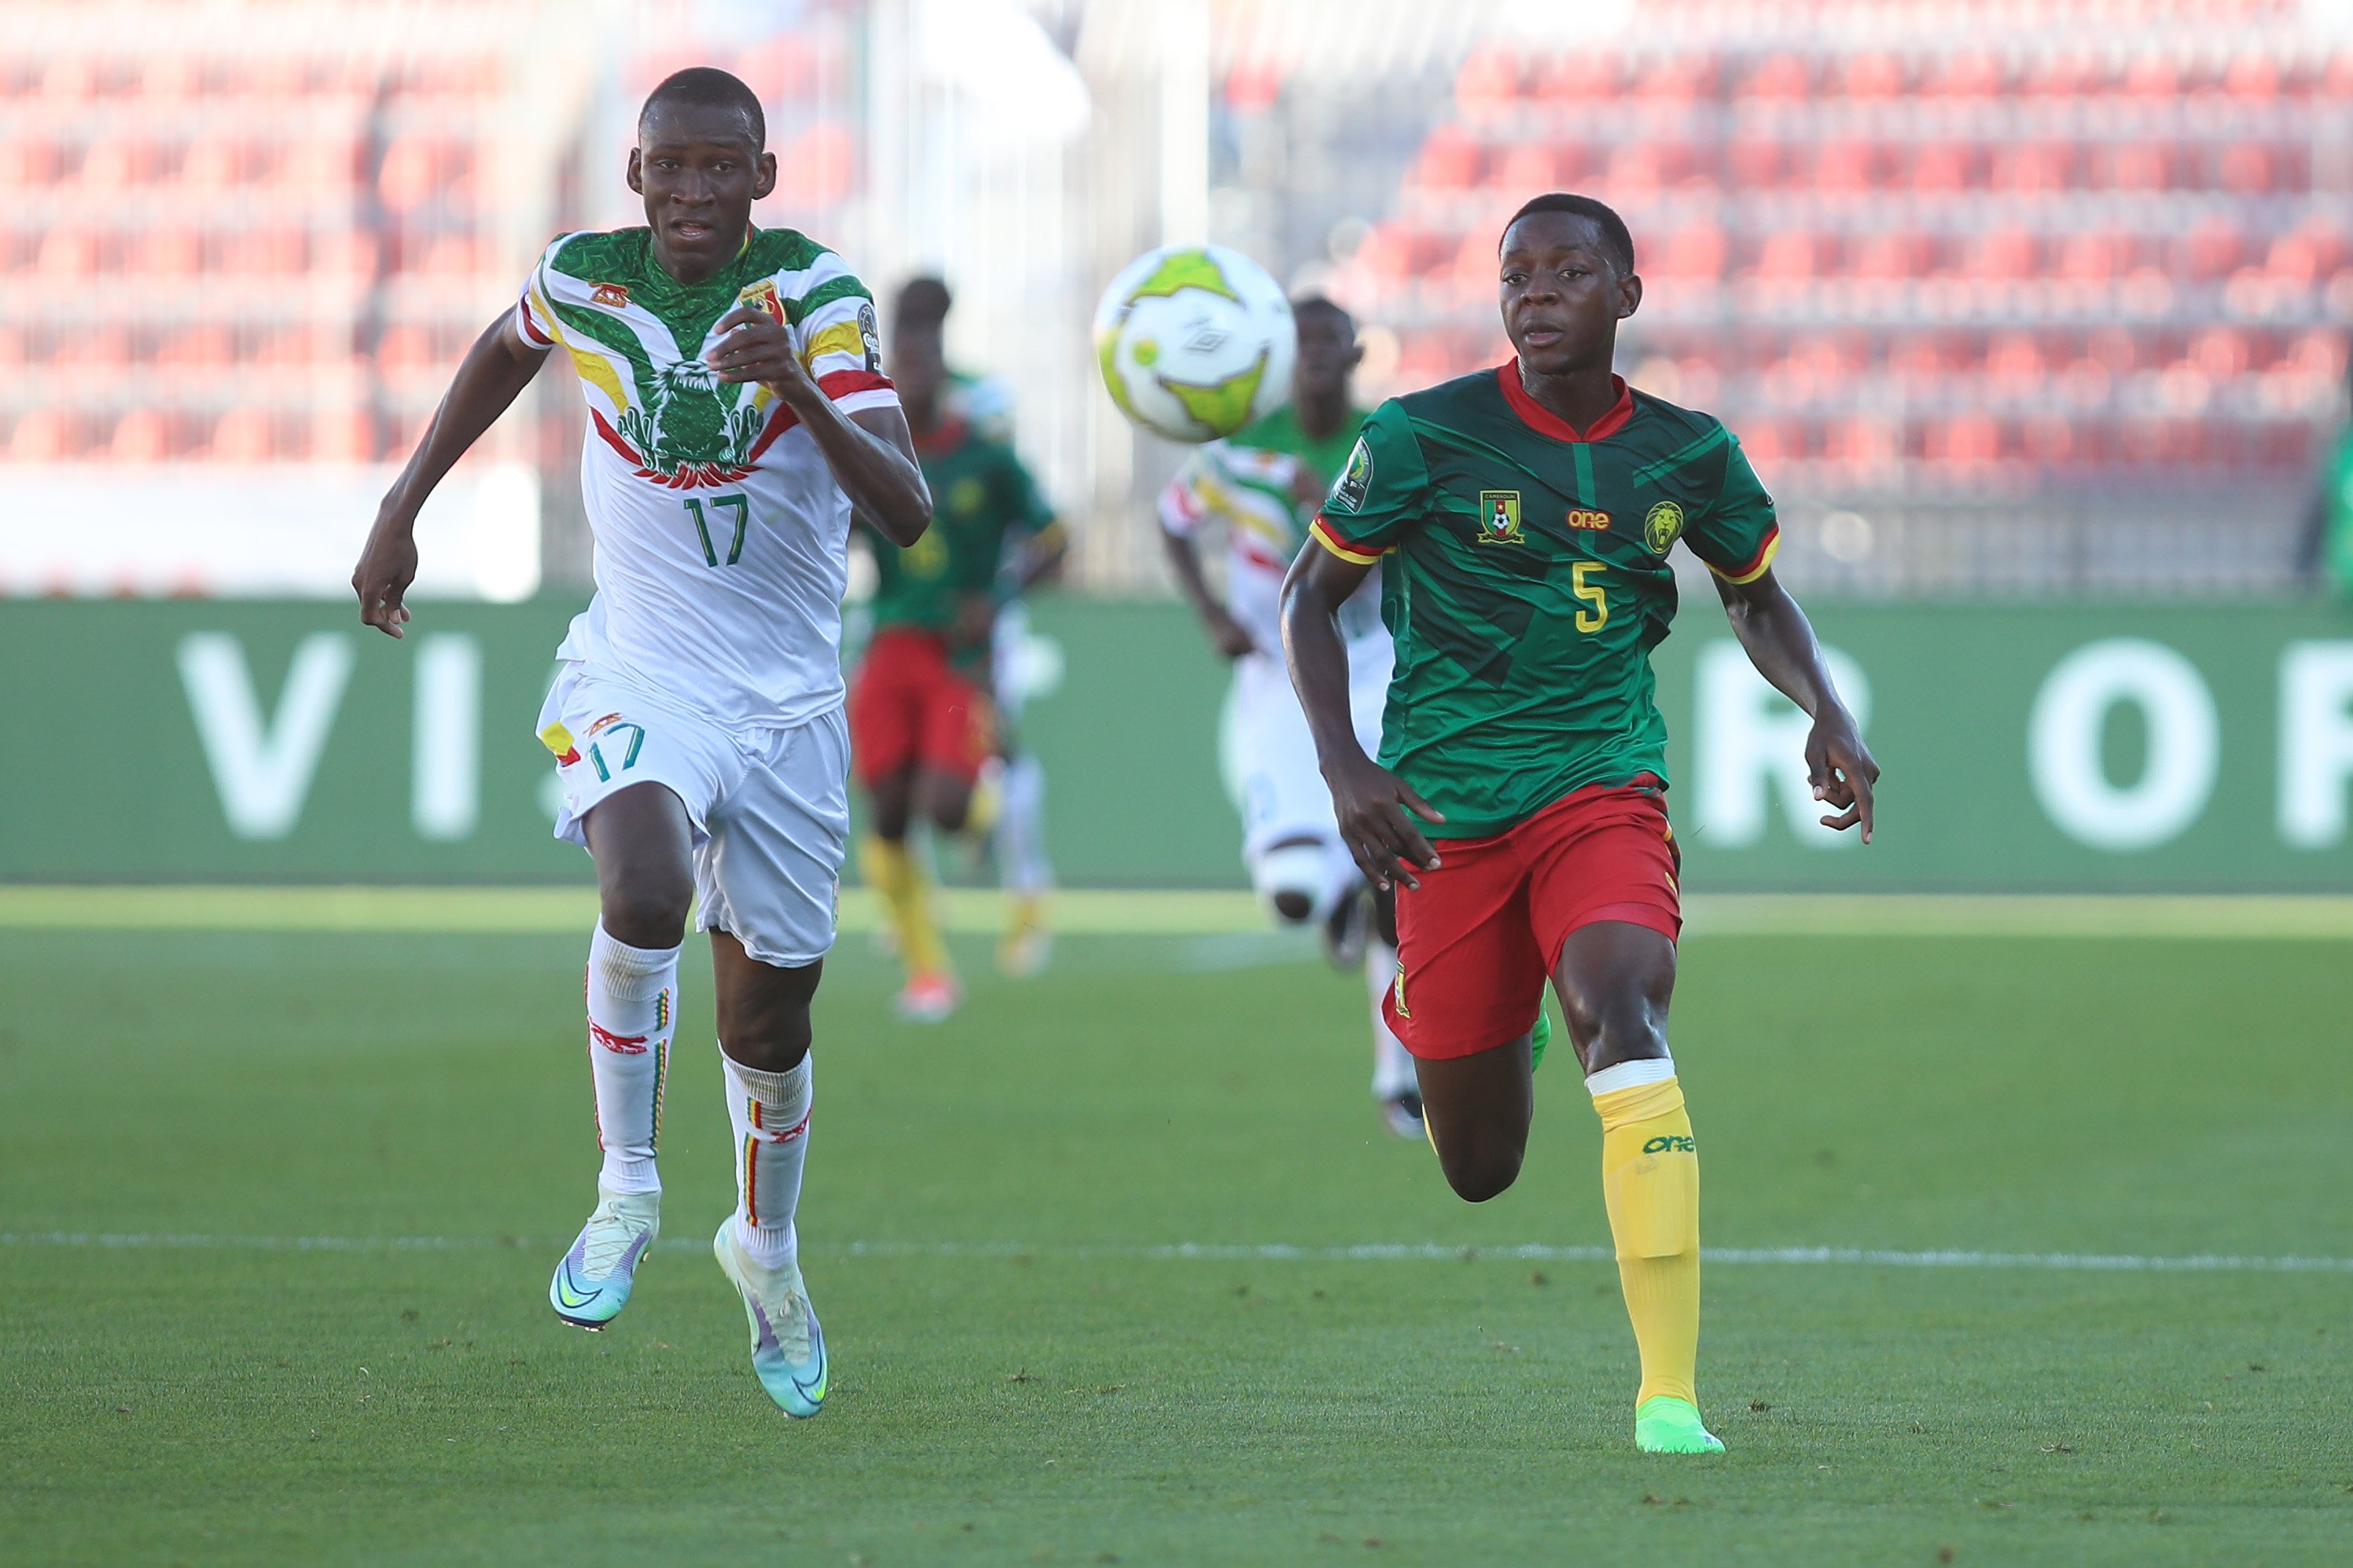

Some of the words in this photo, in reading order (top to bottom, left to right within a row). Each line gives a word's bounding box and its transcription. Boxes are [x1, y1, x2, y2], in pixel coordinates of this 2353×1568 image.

[684, 494, 748, 567] 17
[1568, 511, 1609, 529] one
[1572, 561, 1608, 633] 5
[590, 722, 645, 783] 17
[1642, 1136, 1695, 1154] one
